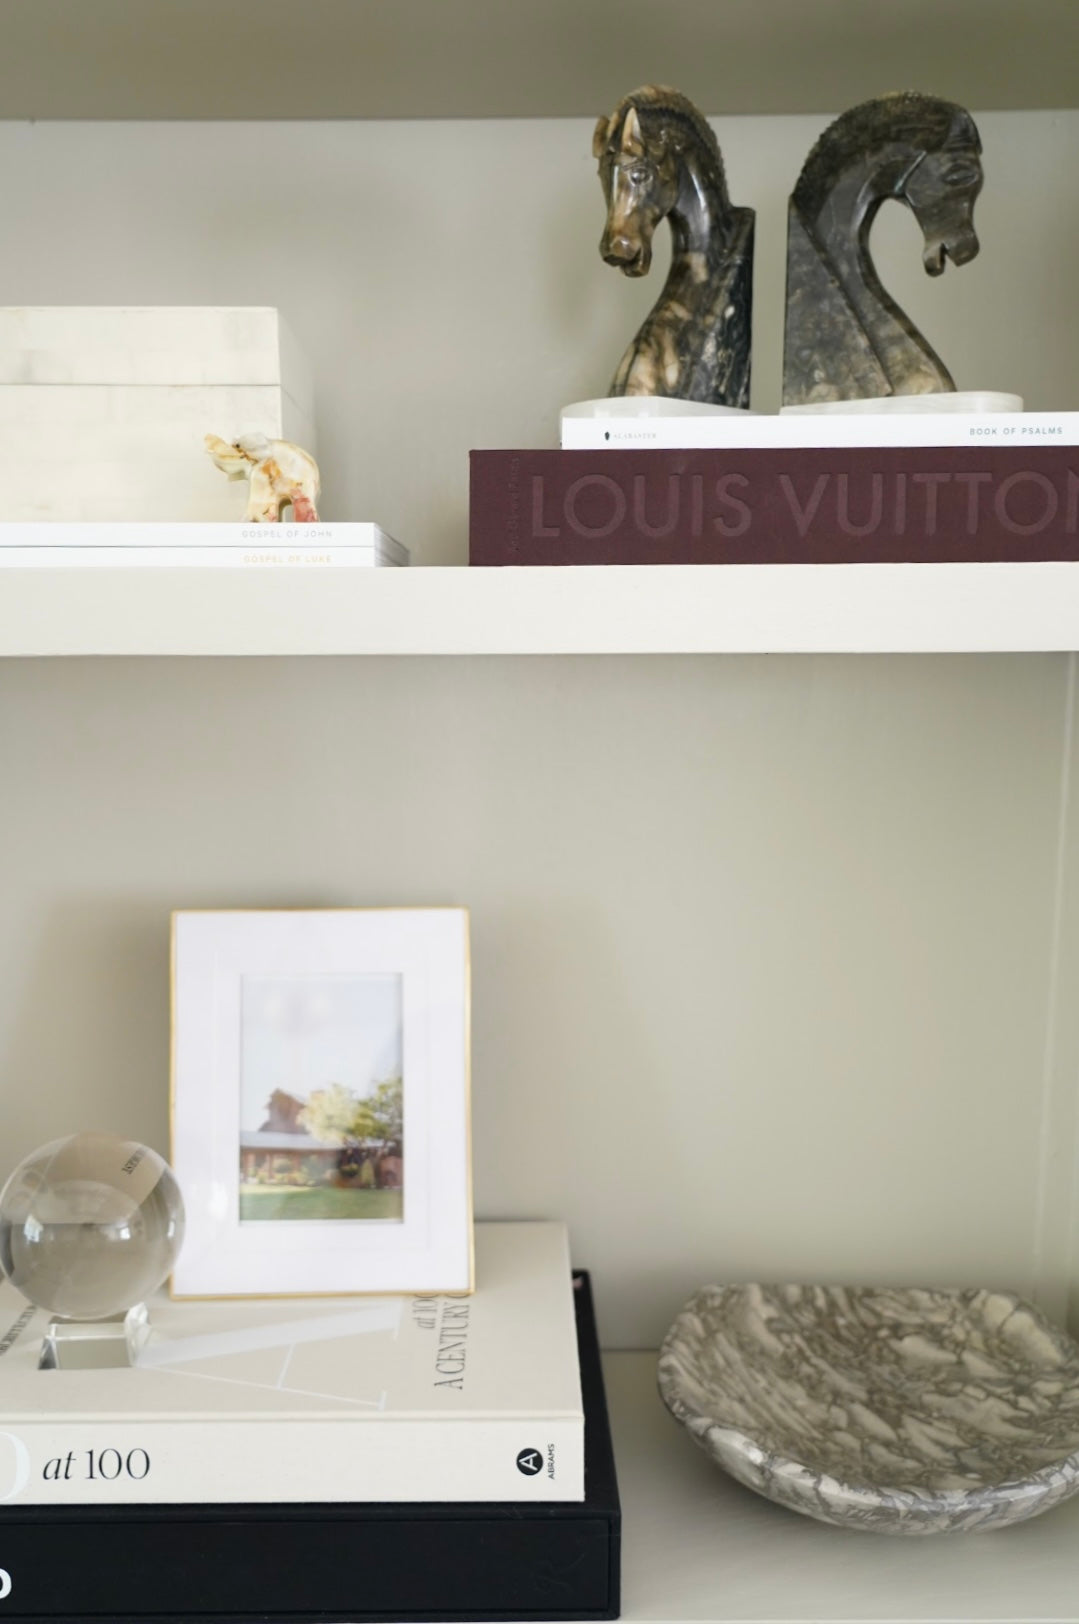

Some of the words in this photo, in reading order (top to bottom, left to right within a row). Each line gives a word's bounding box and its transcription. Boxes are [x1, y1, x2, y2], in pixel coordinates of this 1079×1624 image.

[969, 428, 998, 436] BOOK
[1002, 427, 1017, 435] OF
[1021, 426, 1063, 435] PSALMS
[532, 473, 752, 538] LOUIS
[241, 530, 281, 538] GOSPEL
[286, 530, 300, 538] OF
[304, 530, 332, 538] JOHN
[243, 555, 283, 563] GOSPEL
[288, 555, 301, 563] OF
[304, 555, 332, 563] LUKE
[412, 1295, 438, 1312] 10
[412, 1316, 437, 1329] at
[435, 1301, 470, 1375] CENTURY
[433, 1377, 464, 1390] A
[42, 1450, 77, 1480] at
[85, 1448, 150, 1480] 100
[547, 1443, 555, 1480] ABRAMS
